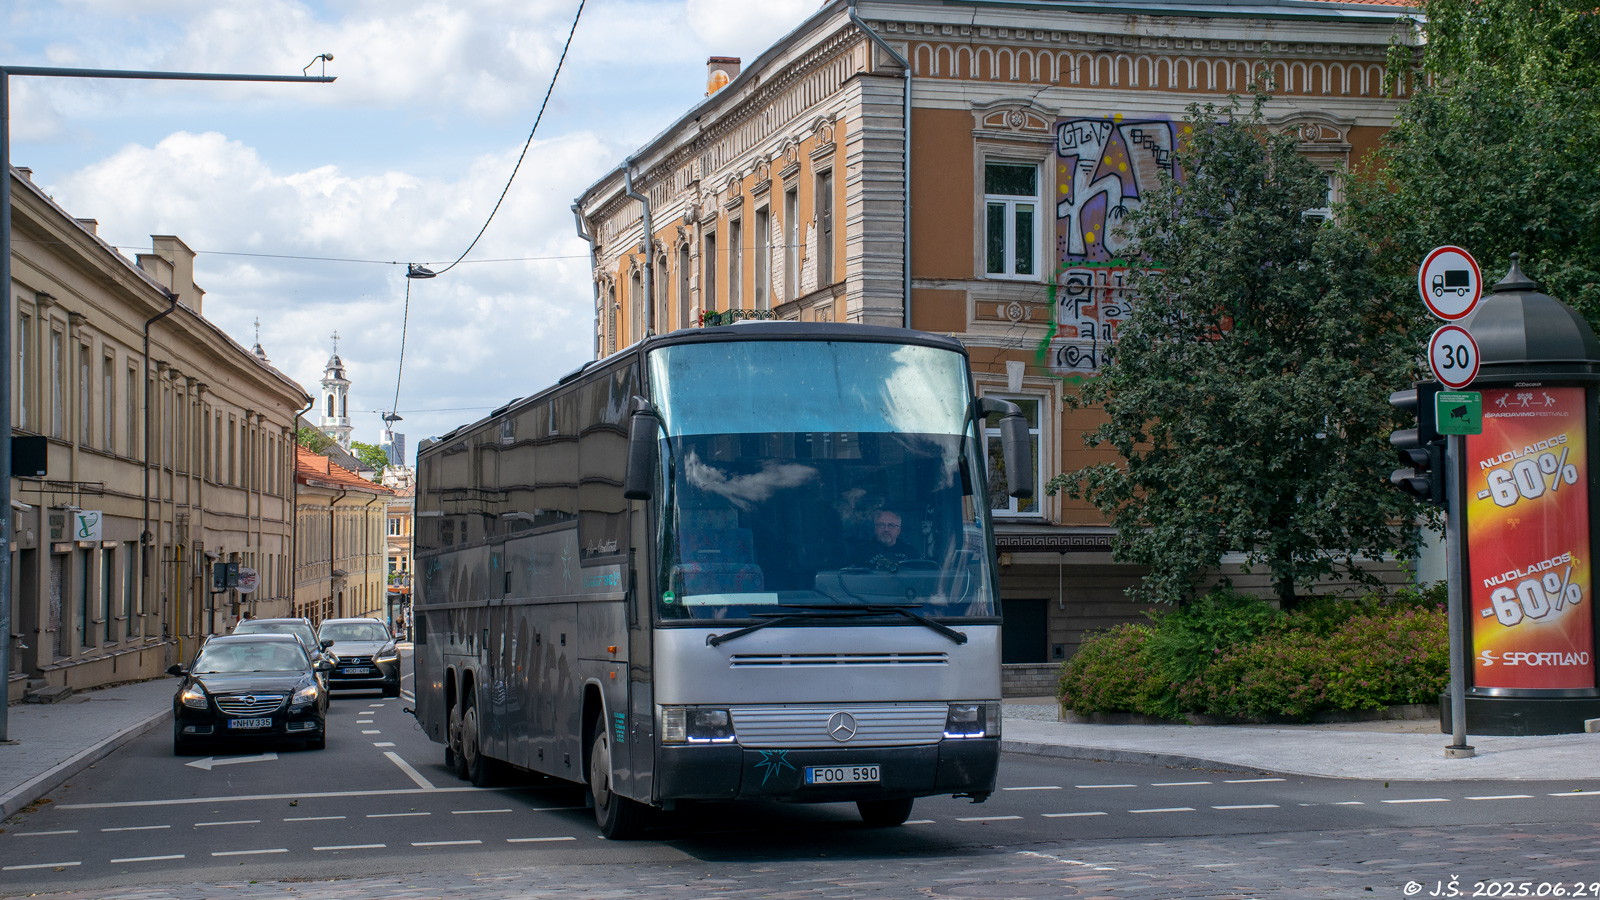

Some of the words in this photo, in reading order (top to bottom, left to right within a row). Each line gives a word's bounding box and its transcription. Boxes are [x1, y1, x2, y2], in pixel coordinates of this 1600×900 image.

[1441, 344, 1469, 369] 30
[1480, 434, 1568, 471] NUOLAIDOS
[1477, 446, 1579, 508] -60%
[1483, 552, 1571, 588] NUOLAIDOS
[1480, 566, 1583, 627] -60%
[1502, 651, 1589, 667] SPORTLAND
[814, 768, 844, 782] FOO
[853, 767, 877, 780] 590
